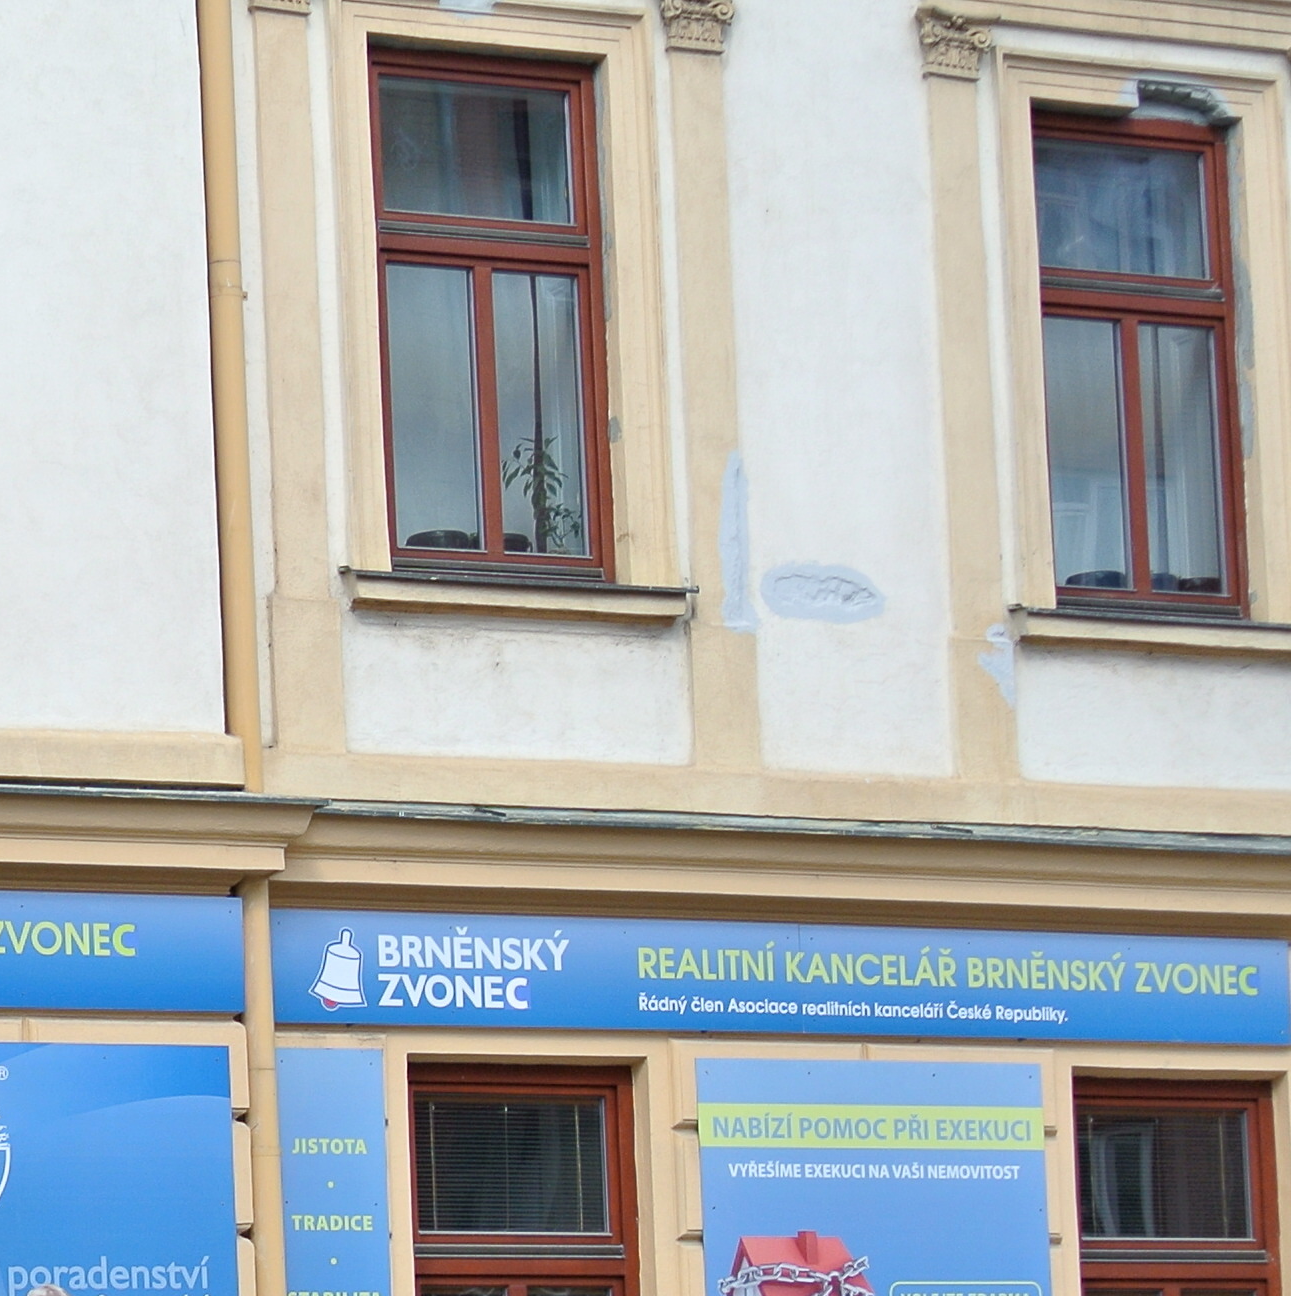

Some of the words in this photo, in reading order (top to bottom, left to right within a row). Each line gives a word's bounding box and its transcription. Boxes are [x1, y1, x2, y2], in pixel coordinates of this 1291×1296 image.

[378, 926, 570, 971] BRNĚNSKÝ
[637, 941, 775, 983] REALITNÍ
[785, 946, 957, 988] KANCELÁŘ
[967, 951, 1127, 992] BRNĚNSKÝ
[1135, 962, 1259, 997] ZVONEC
[377, 973, 530, 1010] ZVONEC
[638, 991, 687, 1015] Řádný
[690, 994, 725, 1013] člen
[728, 997, 798, 1015] Asociace
[802, 998, 871, 1018] realitních
[874, 1000, 944, 1020] kanceláří
[945, 1000, 992, 1021] České
[995, 1005, 1069, 1025] Republiky.
[711, 1112, 793, 1139] NABÍZÍ
[799, 1116, 888, 1141] POMOC
[894, 1114, 930, 1141] PŘI
[935, 1118, 1033, 1142] EXEKUCI
[292, 1138, 368, 1155] JISTOTA
[728, 1160, 802, 1179] VYŘEŠÍME
[804, 1163, 866, 1179] EXEKUCI
[869, 1164, 890, 1180] NA
[892, 1162, 924, 1180] VAŠI
[928, 1164, 1020, 1181] NEMOVITOST
[291, 1214, 373, 1231] TRADICE
